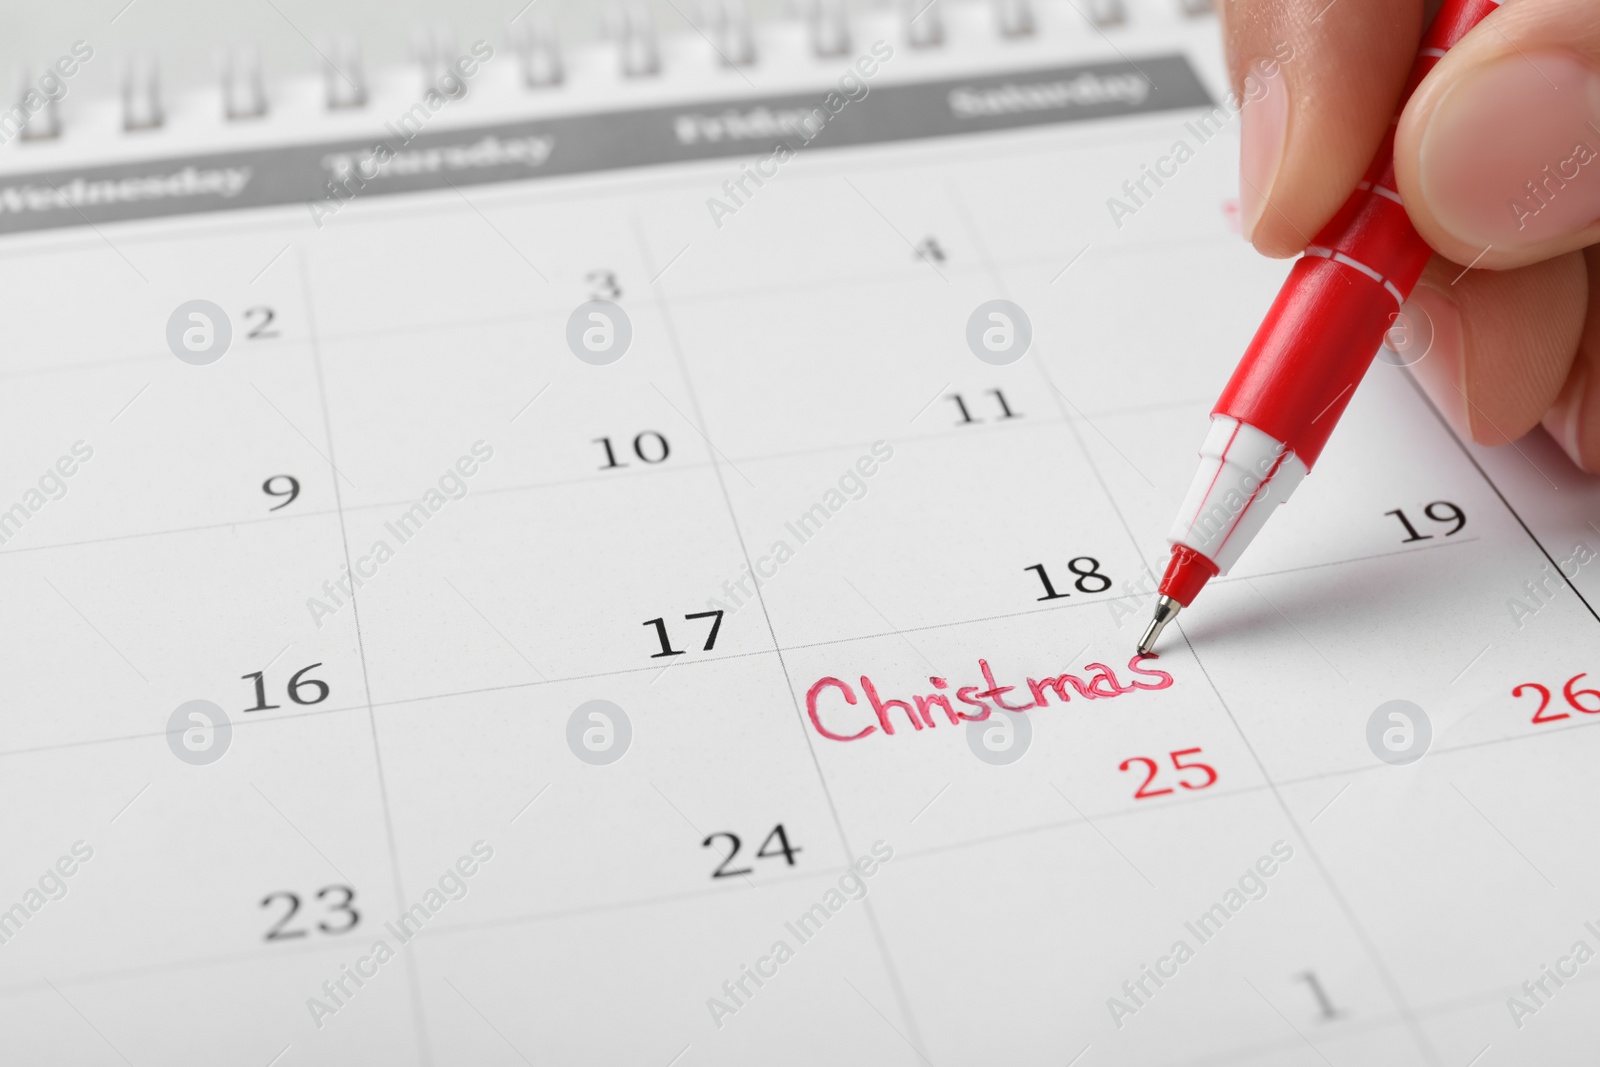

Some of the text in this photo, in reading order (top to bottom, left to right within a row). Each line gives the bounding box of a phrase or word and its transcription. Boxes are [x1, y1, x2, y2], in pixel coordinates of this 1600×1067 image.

[949, 73, 1147, 118] Saturday
[585, 269, 623, 304] 3
[243, 307, 280, 341] 2
[945, 388, 1022, 426] 11
[592, 431, 671, 470] 10
[262, 474, 301, 512] 9
[1384, 501, 1467, 544] 19
[1023, 556, 1112, 602] 18
[642, 609, 725, 659] 17
[241, 661, 330, 713] 16
[806, 653, 1174, 742] Christmas
[1511, 672, 1600, 725] 26
[1118, 747, 1219, 801] 25
[701, 823, 803, 879] 24
[259, 885, 362, 942] 23
